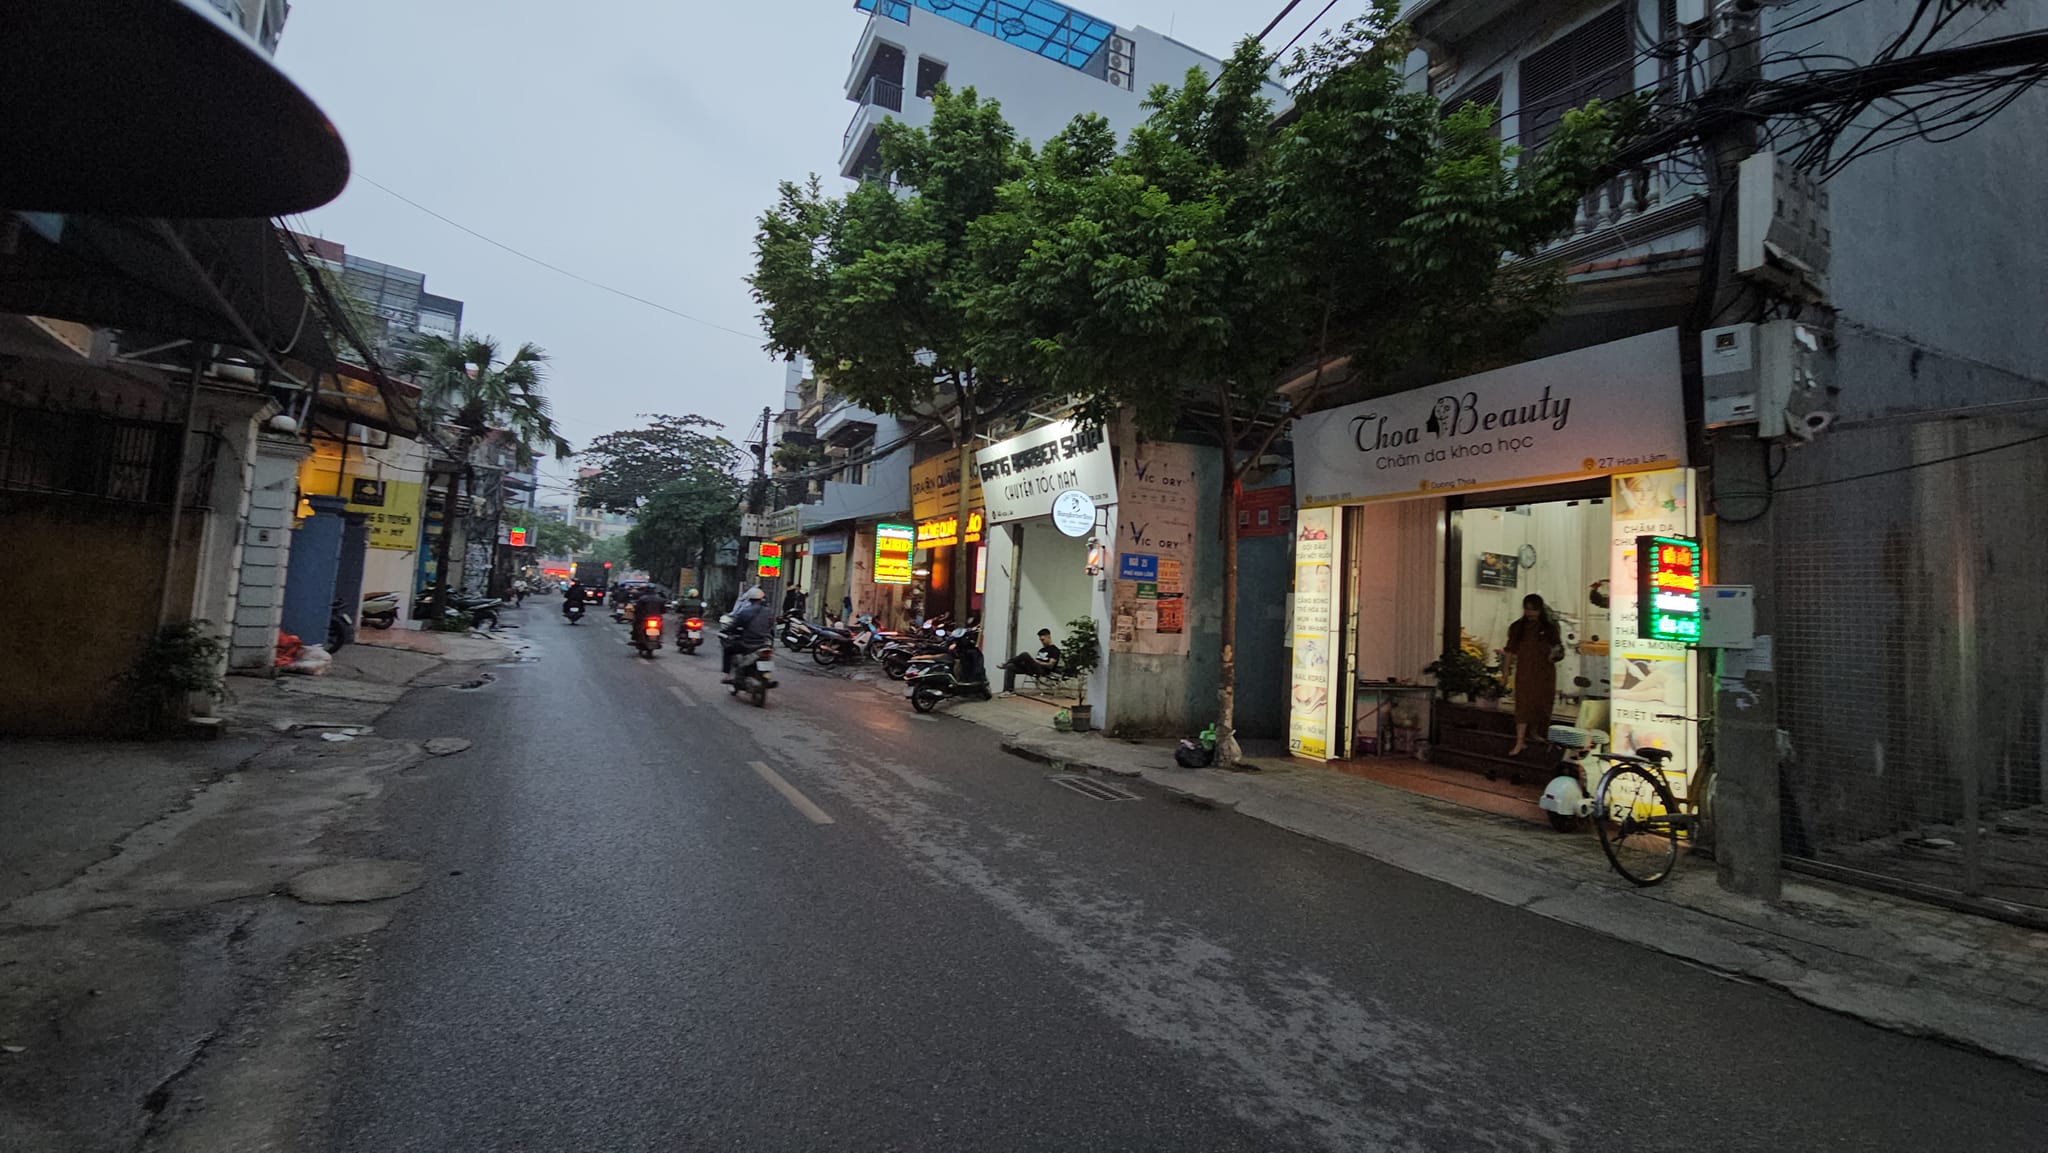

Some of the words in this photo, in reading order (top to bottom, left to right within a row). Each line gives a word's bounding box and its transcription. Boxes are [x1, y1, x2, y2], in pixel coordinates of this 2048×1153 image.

[1349, 413, 1420, 451] Thoa
[1441, 385, 1571, 437] Beauty
[1424, 449, 1446, 464] da
[1451, 441, 1493, 459] khoa
[1497, 434, 1534, 453] học
[1598, 457, 1615, 469] 27
[1291, 739, 1302, 749] 27
[1614, 804, 1632, 818] 27
